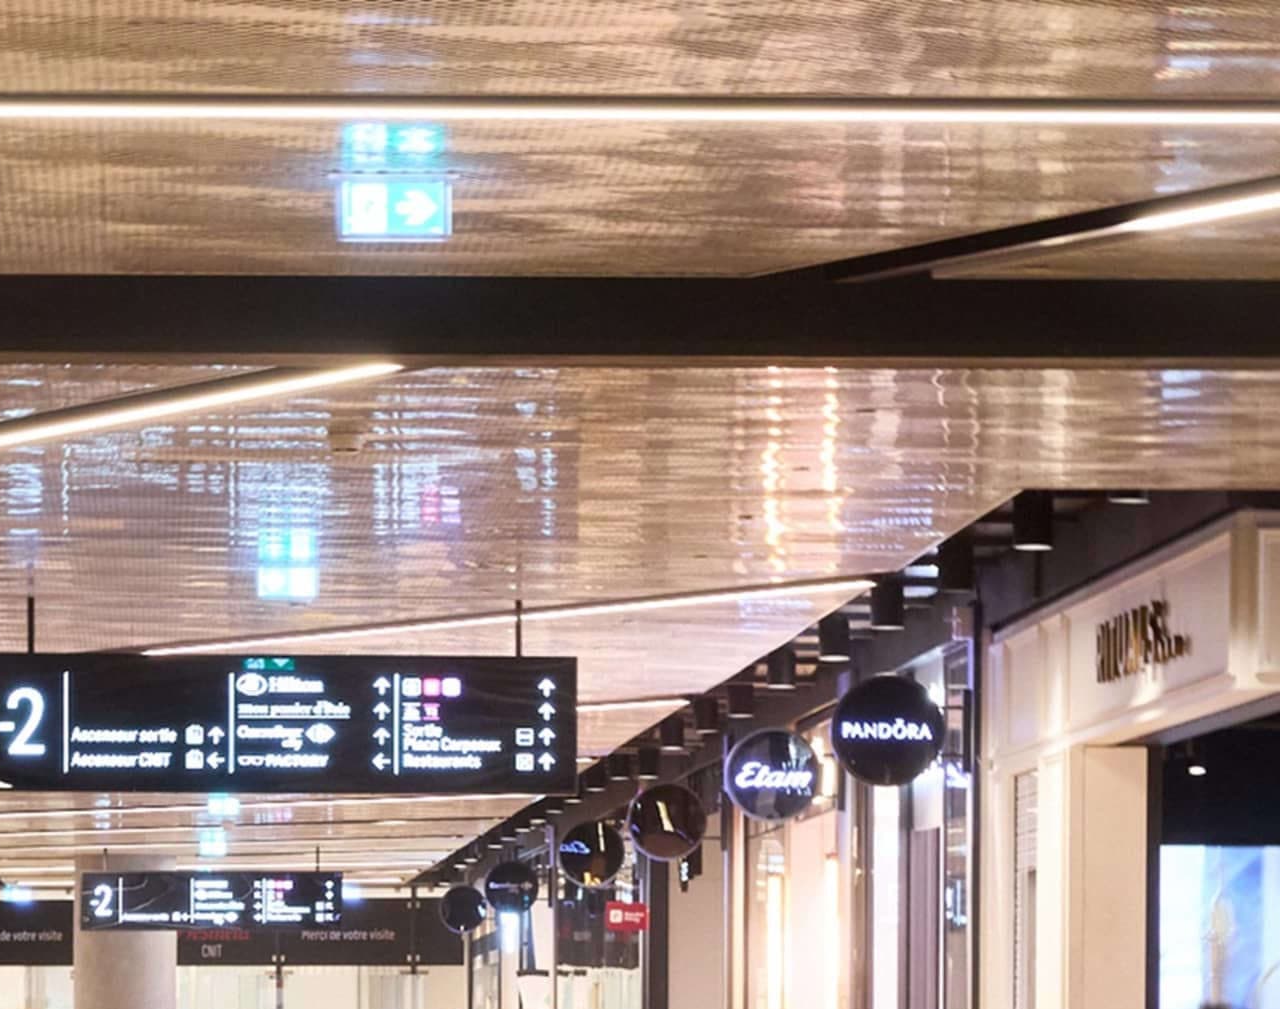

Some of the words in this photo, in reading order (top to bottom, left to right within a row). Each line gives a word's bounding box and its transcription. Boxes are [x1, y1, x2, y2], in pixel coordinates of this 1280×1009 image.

[734, 761, 813, 789] Etam
[89, 884, 113, 917] -2
[200, 943, 223, 958] CNIT
